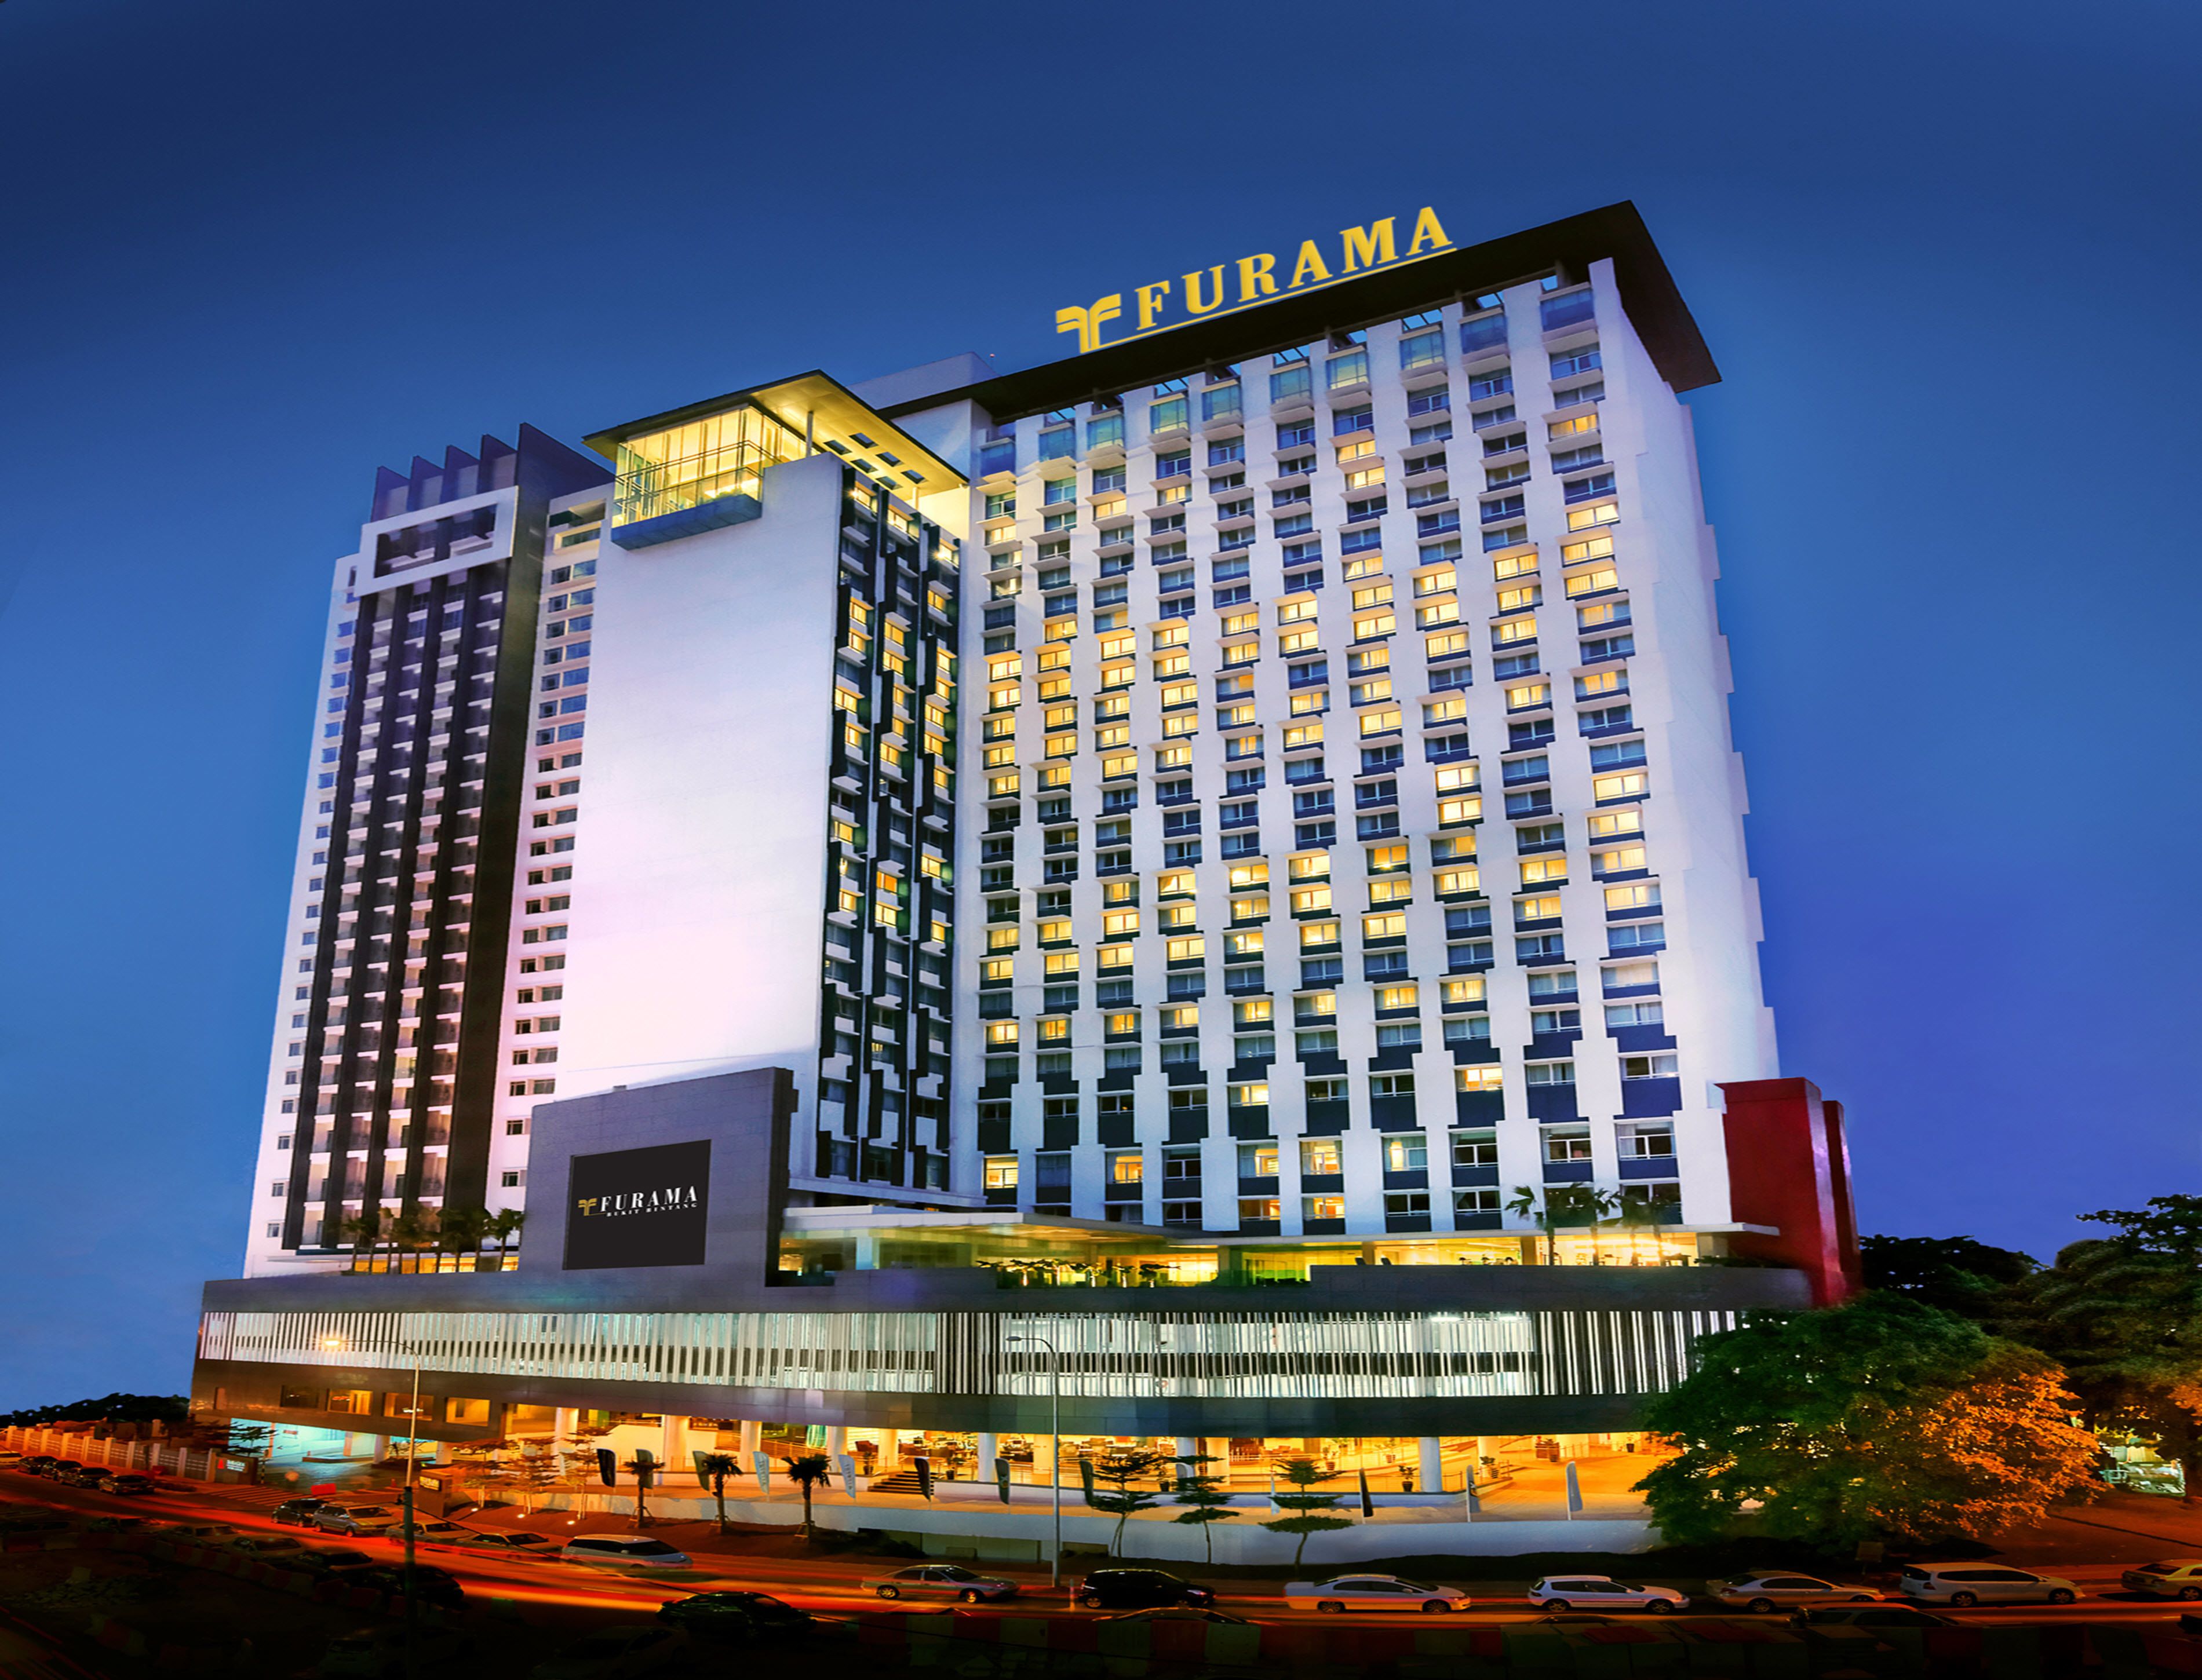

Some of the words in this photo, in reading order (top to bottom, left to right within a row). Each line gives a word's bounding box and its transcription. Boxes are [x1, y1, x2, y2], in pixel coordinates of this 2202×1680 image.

[1135, 206, 1453, 330] FURAMA
[601, 1186, 697, 1212] FURAMA
[646, 1203, 697, 1212] BINTANG
